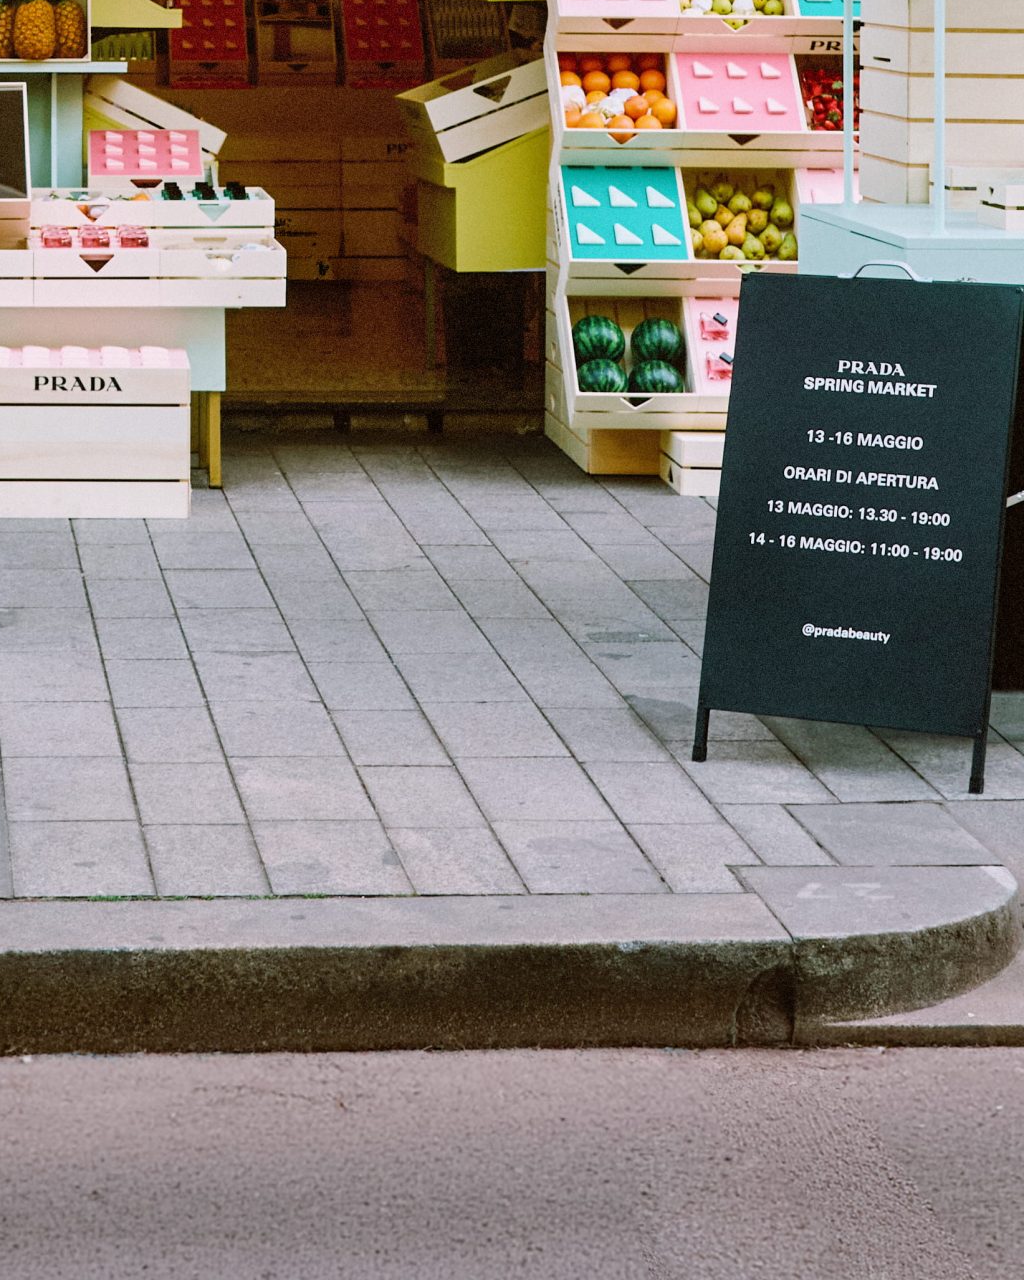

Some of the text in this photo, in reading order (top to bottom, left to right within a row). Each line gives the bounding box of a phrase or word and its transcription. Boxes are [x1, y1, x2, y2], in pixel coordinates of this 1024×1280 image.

[838, 360, 905, 376] PRADA
[35, 376, 121, 391] PRADA
[804, 377, 937, 397] SPRING MARKET
[808, 430, 824, 443] 13
[858, 433, 923, 450] MAGGIO
[784, 466, 938, 490] ORARI DI APERTURA
[768, 500, 783, 512] 13
[788, 502, 853, 518] MAGGIO:
[859, 508, 897, 522] 13.30
[912, 512, 950, 526] 19:00
[750, 532, 765, 545] 14
[780, 535, 795, 547] 16
[800, 537, 865, 553] MAGGIO:
[871, 543, 909, 557] 11:00
[924, 547, 962, 562] 19:00
[802, 624, 890, 644] @pradabeauty
